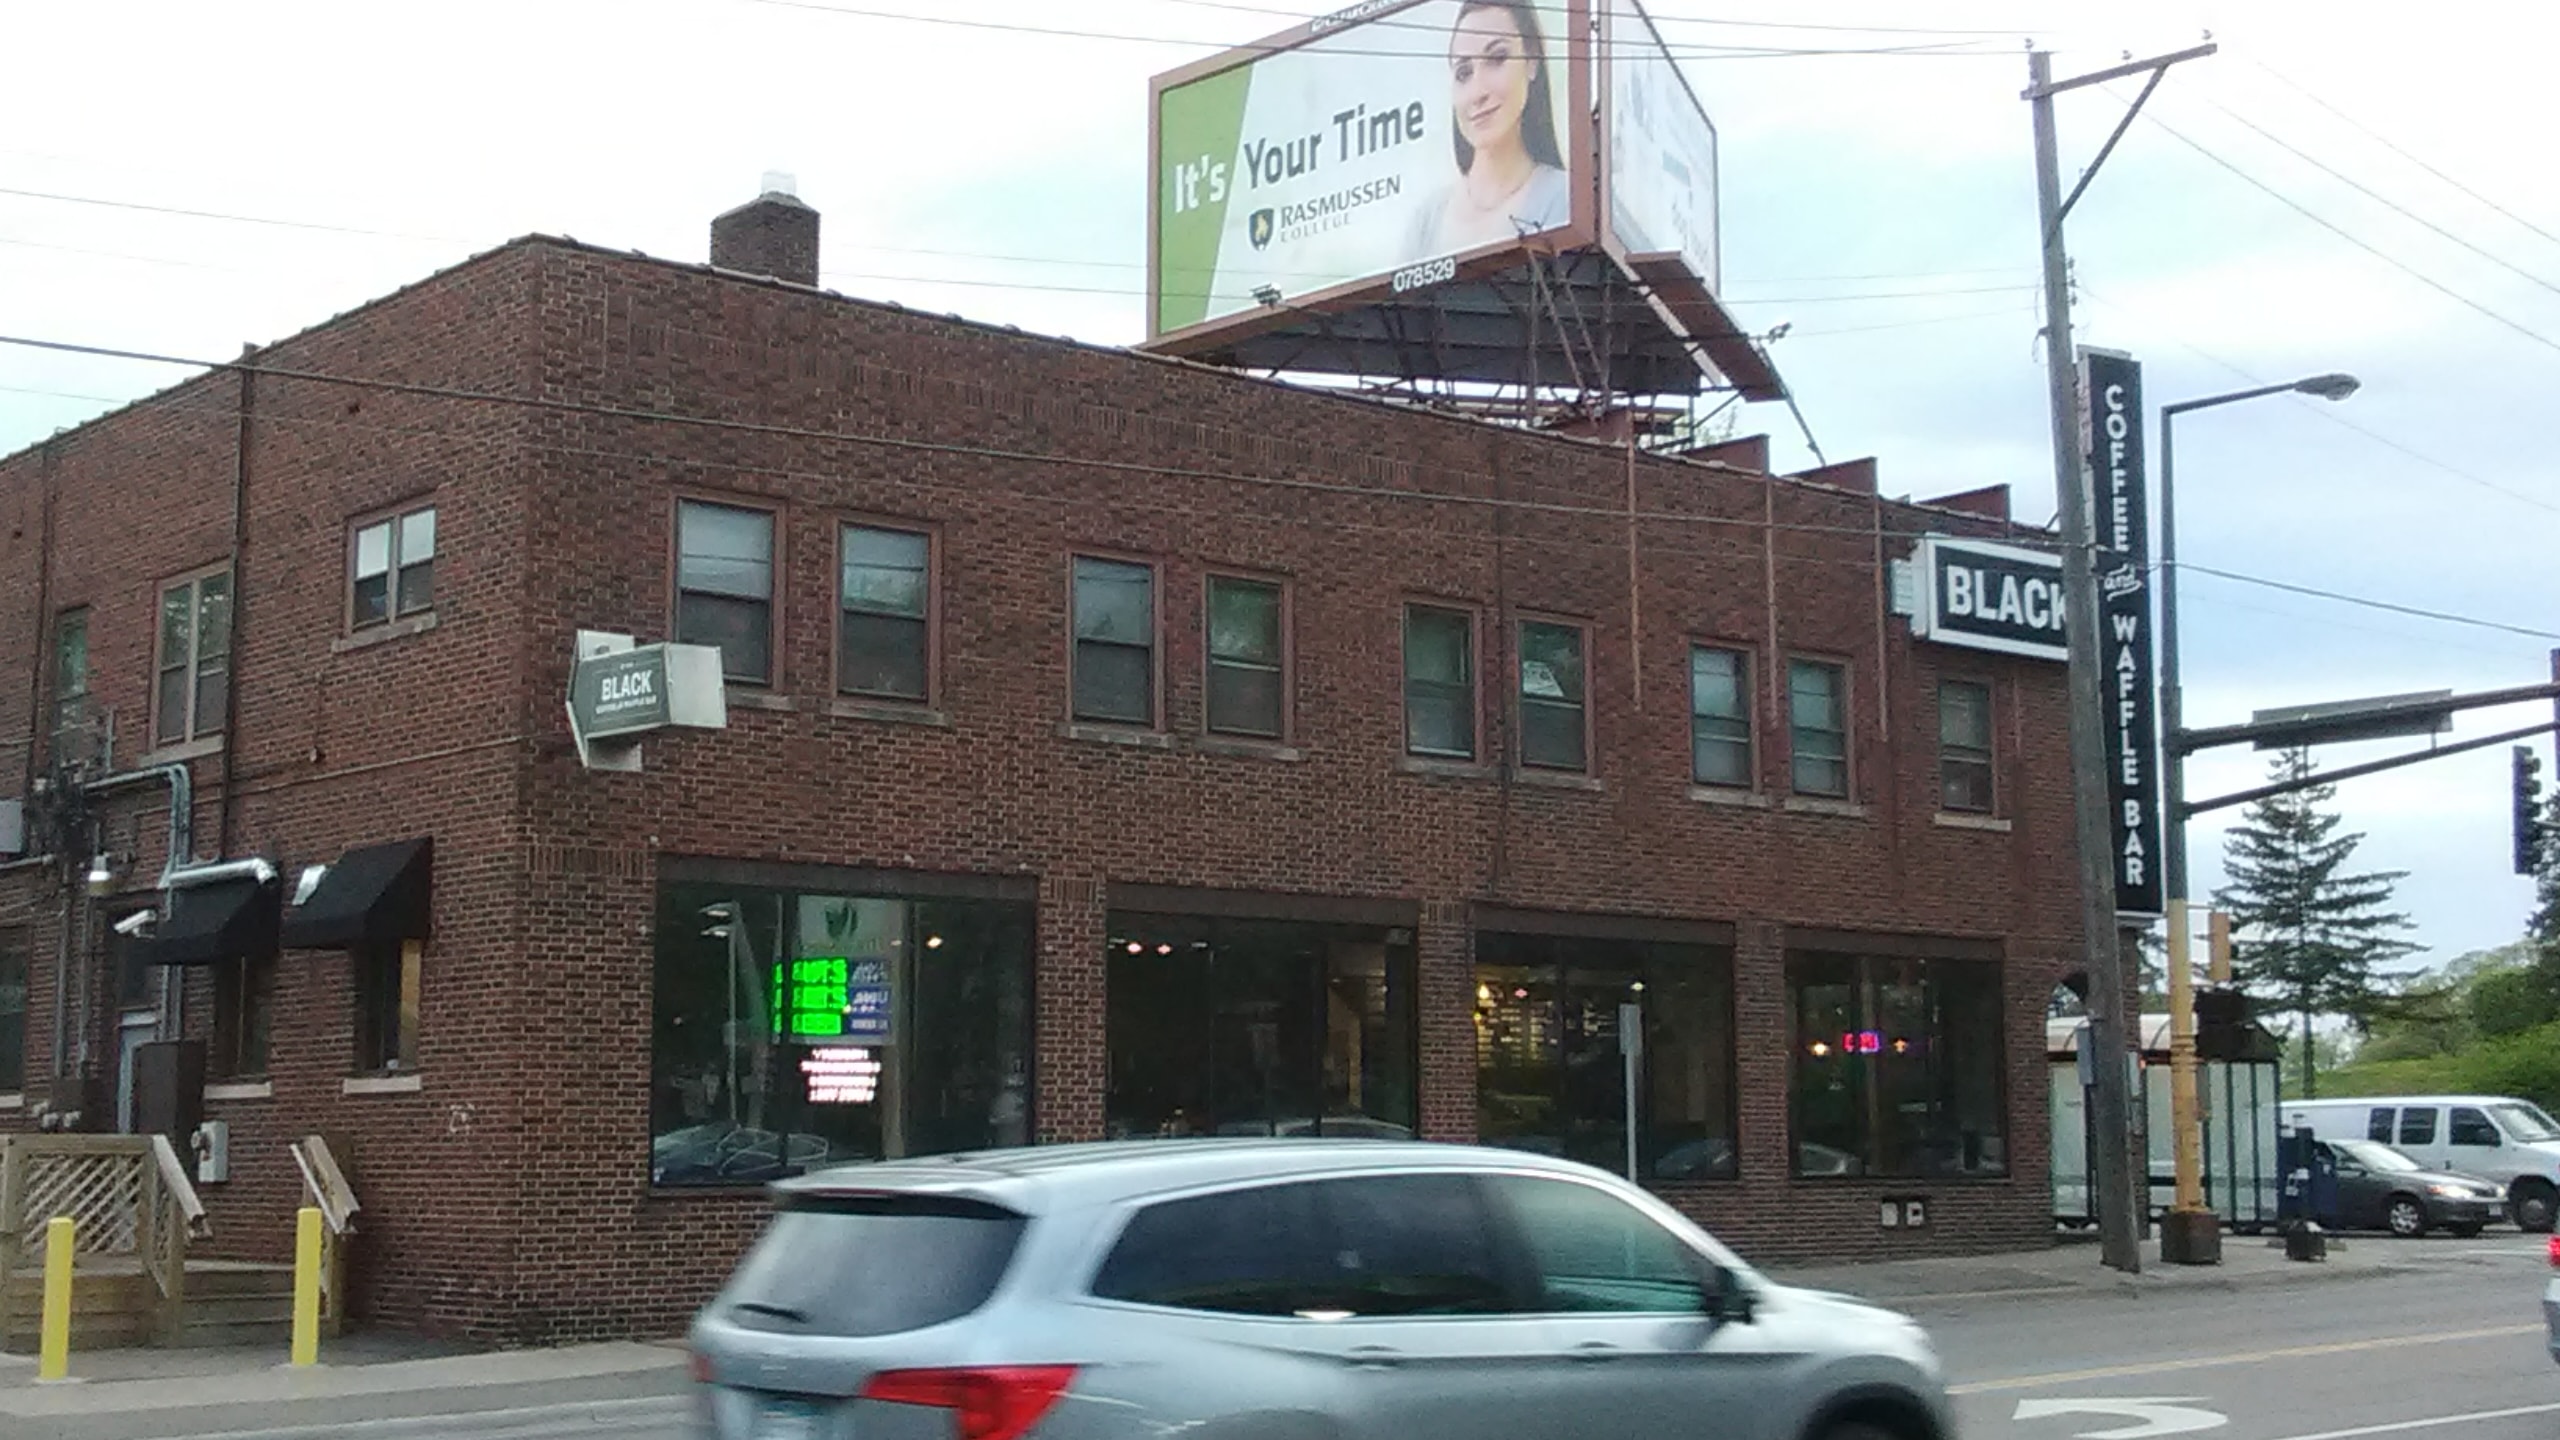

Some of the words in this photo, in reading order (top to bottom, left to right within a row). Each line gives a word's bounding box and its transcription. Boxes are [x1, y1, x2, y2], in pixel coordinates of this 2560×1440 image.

[1175, 154, 1227, 213] It's
[1242, 133, 1321, 190] Your
[1333, 100, 1424, 161] Time
[1280, 174, 1401, 228] RASMUSSEN
[1280, 212, 1351, 243] COLLEGE
[1393, 258, 1457, 292] 078529
[2105, 384, 2129, 551] COFFEE
[1946, 565, 2067, 630] BLACK
[2104, 563, 2142, 599] and
[601, 669, 652, 701] BLACK
[2112, 614, 2139, 785] WAFFLE
[2121, 799, 2144, 886] BAR
